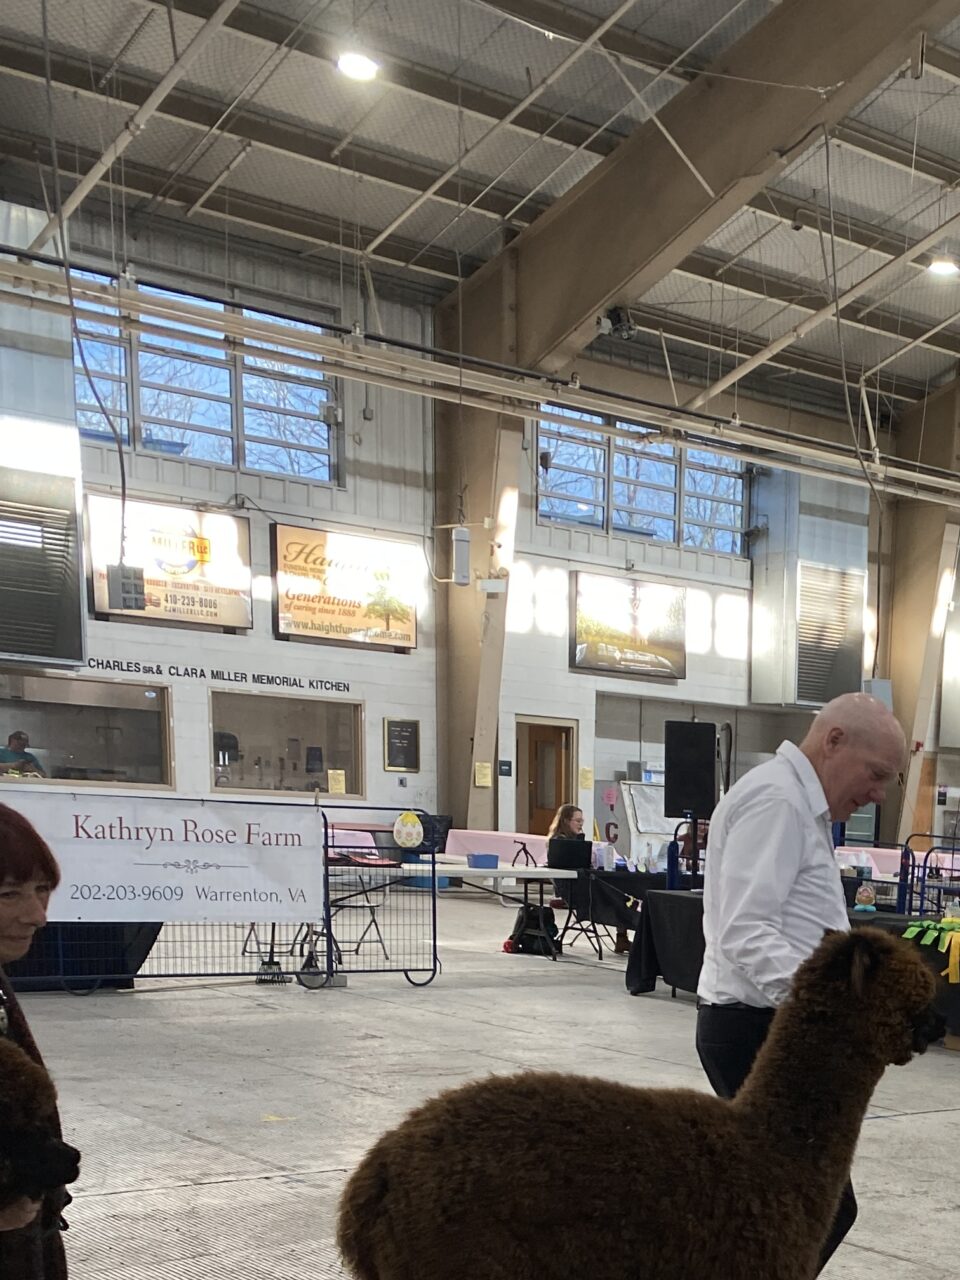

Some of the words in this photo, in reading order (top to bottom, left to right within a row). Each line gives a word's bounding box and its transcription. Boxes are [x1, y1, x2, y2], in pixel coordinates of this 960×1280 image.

[163, 593, 218, 609] 410-239-8006
[285, 587, 362, 609] Generations
[88, 657, 141, 673] CHARLES
[168, 665, 207, 680] CLARA
[210, 669, 248, 684] MILLER
[252, 673, 305, 689] MEMORIAL
[308, 678, 350, 693] KITCHEN
[73, 814, 175, 850] Kathryn
[182, 818, 237, 844] Rose
[245, 822, 303, 847] Farm
[195, 885, 283, 905] Warrenton,
[287, 887, 307, 903] VA
